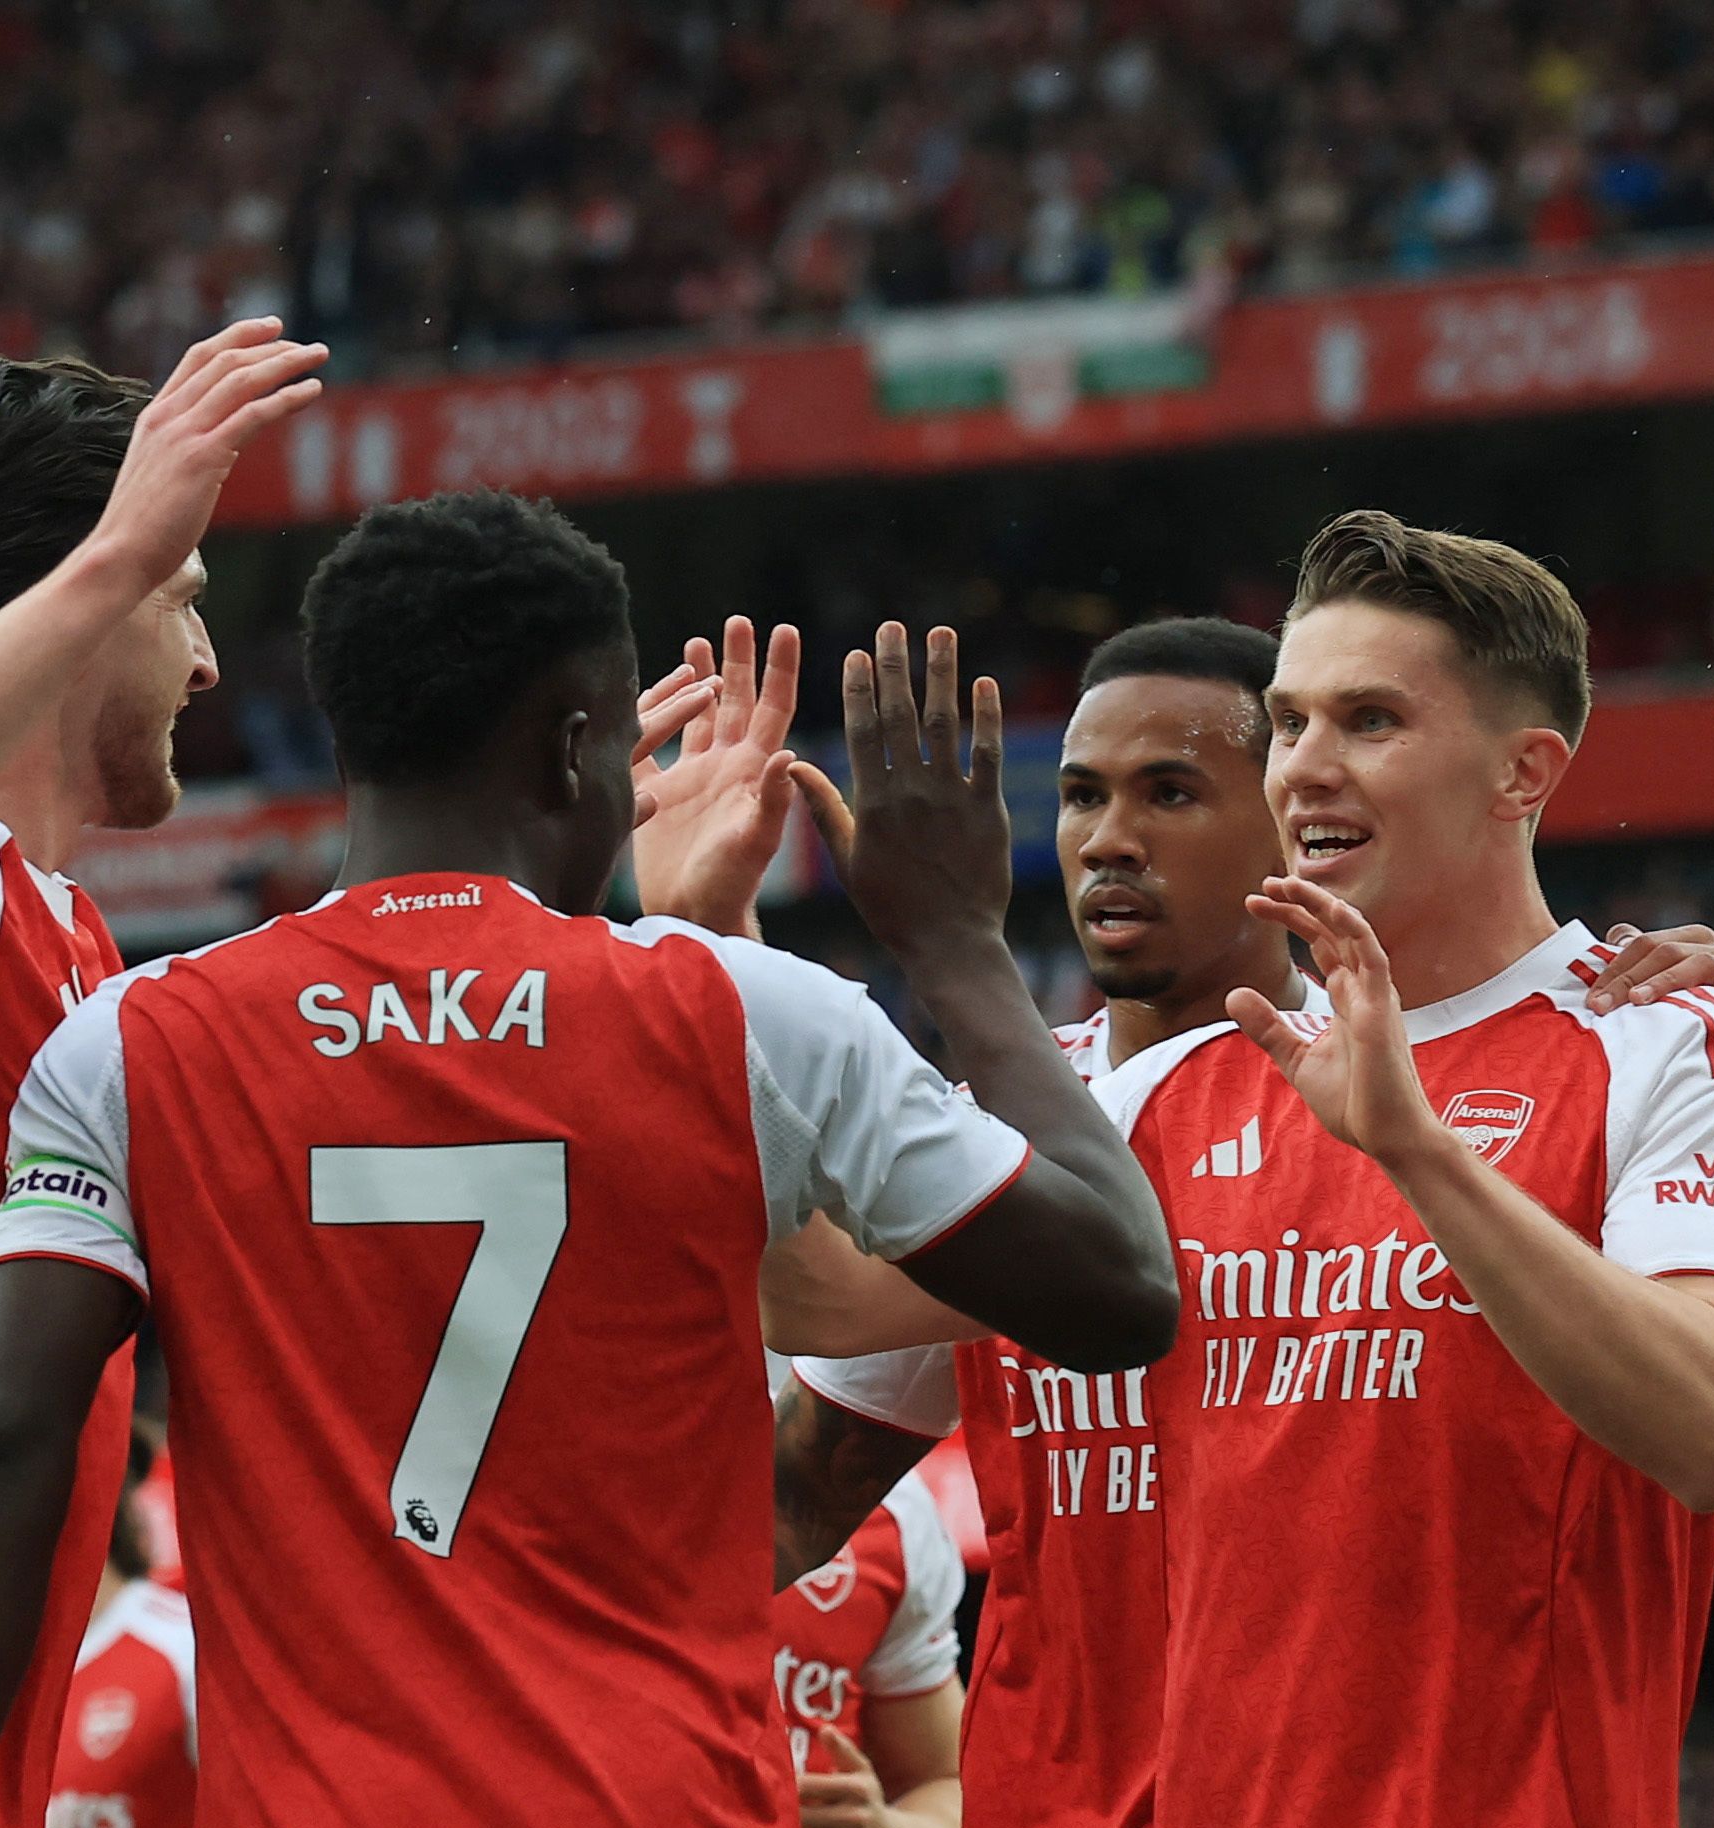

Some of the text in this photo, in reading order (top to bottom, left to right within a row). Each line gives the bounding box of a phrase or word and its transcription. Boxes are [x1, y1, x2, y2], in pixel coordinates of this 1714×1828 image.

[372, 883, 482, 917] Arsenal
[297, 968, 548, 1058] SAKA
[1455, 1104, 1521, 1121] Arsenal
[7, 1167, 107, 1208] ptain
[309, 1140, 568, 1560] 7
[1201, 1328, 1425, 1409] FLY BETTER
